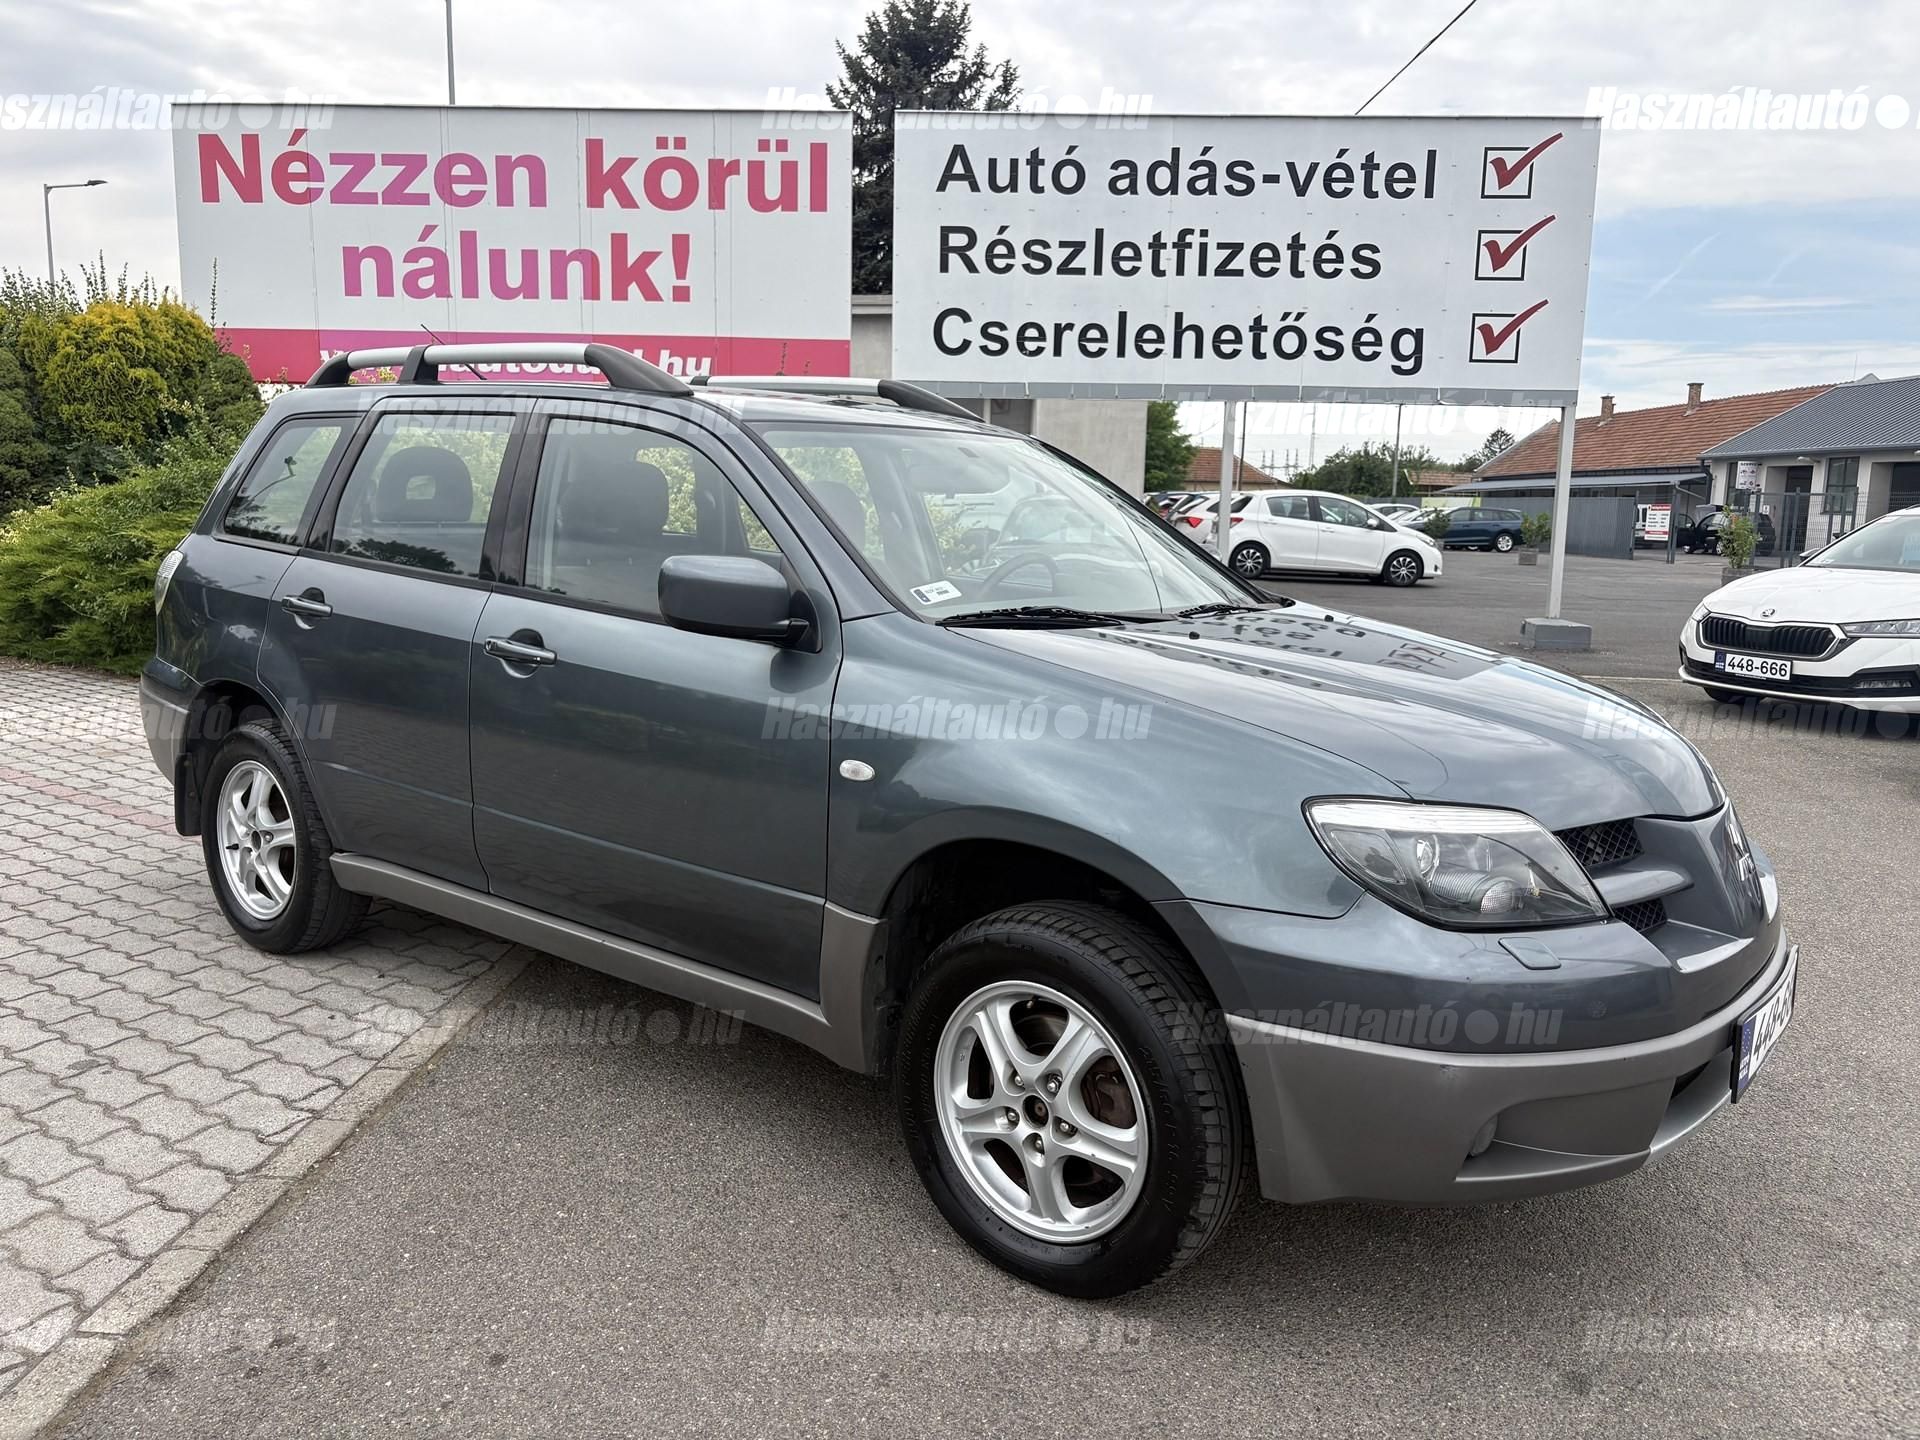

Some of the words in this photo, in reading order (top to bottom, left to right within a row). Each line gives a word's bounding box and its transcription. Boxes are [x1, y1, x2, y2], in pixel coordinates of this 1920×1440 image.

[197, 128, 547, 208] Nézzen
[585, 137, 828, 213] körül
[936, 144, 1086, 195] Autó
[1108, 145, 1437, 199] adás-vétel
[342, 224, 691, 302] nálunk!
[939, 225, 1382, 279] Részletfizetés
[933, 307, 1424, 376] Cserelehetőség
[1728, 656, 1788, 677] 448-666
